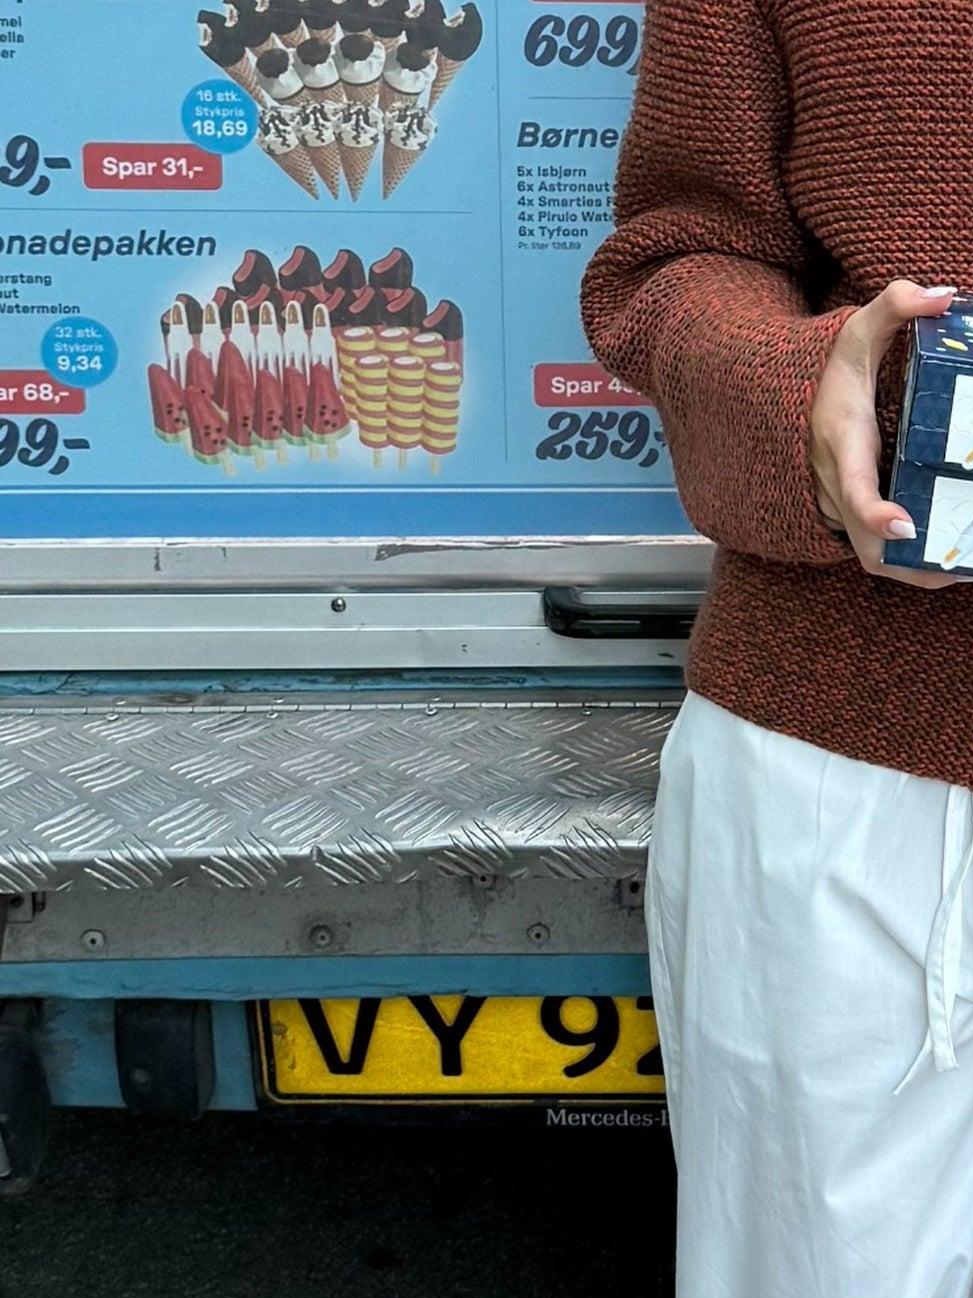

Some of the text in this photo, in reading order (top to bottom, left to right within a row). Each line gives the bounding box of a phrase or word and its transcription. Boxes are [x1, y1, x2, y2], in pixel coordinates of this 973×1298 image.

[197, 89, 242, 102] 16 stk.
[192, 120, 249, 139] 18,69
[517, 122, 619, 148] Børne
[102, 157, 204, 180] Spar 31,-
[517, 166, 587, 179] 5x Isbjørn
[517, 181, 610, 192] 6x Astronaut
[517, 196, 534, 207] 4x
[538, 196, 602, 207] Smarties
[518, 211, 534, 222] 4x
[538, 211, 578, 222] Pirulo
[518, 226, 588, 239] 6x Tyfoon
[0, 229, 217, 261] nadepakken
[55, 326, 102, 338] 32 stk.
[57, 355, 103, 374] 9,34
[23, 383, 70, 405] 68,-
[551, 376, 603, 397] Spar
[298, 996, 488, 1078] VY
